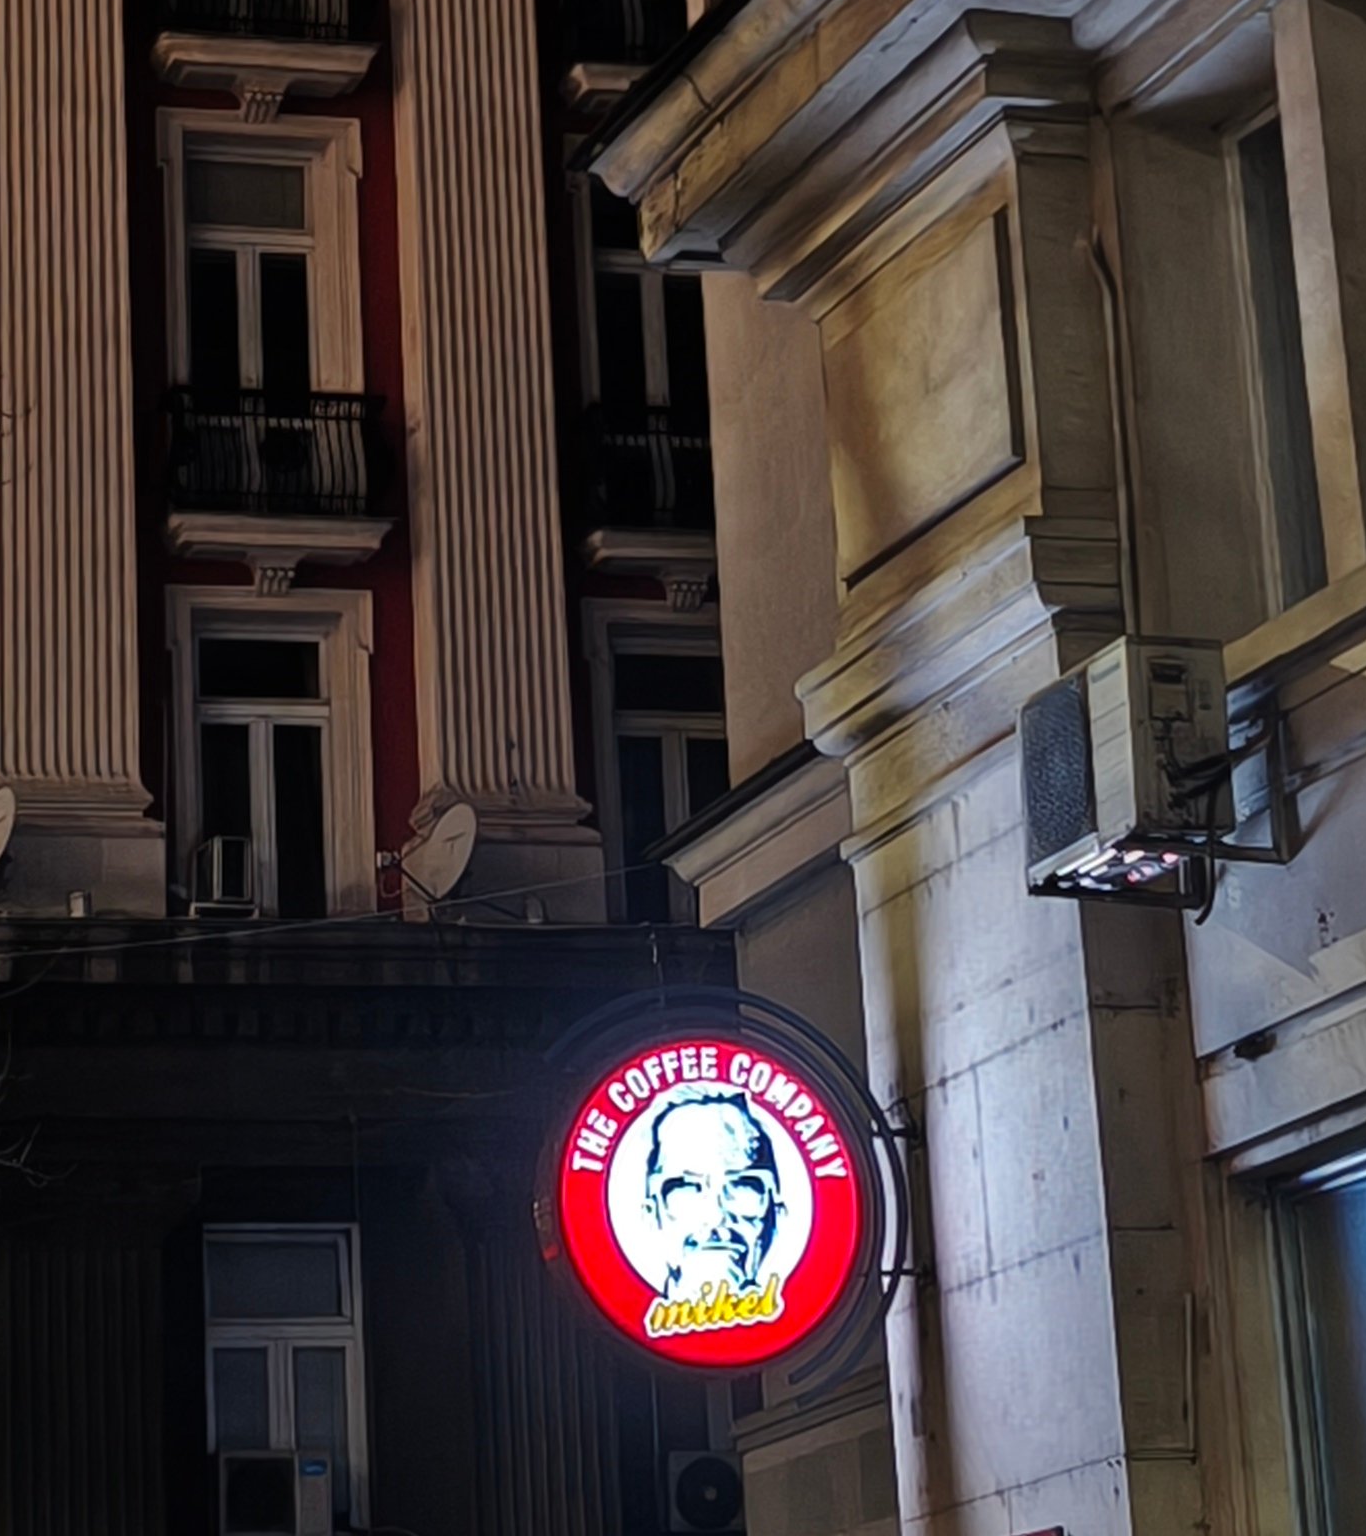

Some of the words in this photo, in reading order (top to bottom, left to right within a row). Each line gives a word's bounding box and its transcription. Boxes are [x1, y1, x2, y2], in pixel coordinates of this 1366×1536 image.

[572, 1108, 618, 1173] THE
[608, 1047, 718, 1113] COFFEE
[730, 1053, 848, 1180] COMPANY
[648, 1272, 780, 1334] mikel
